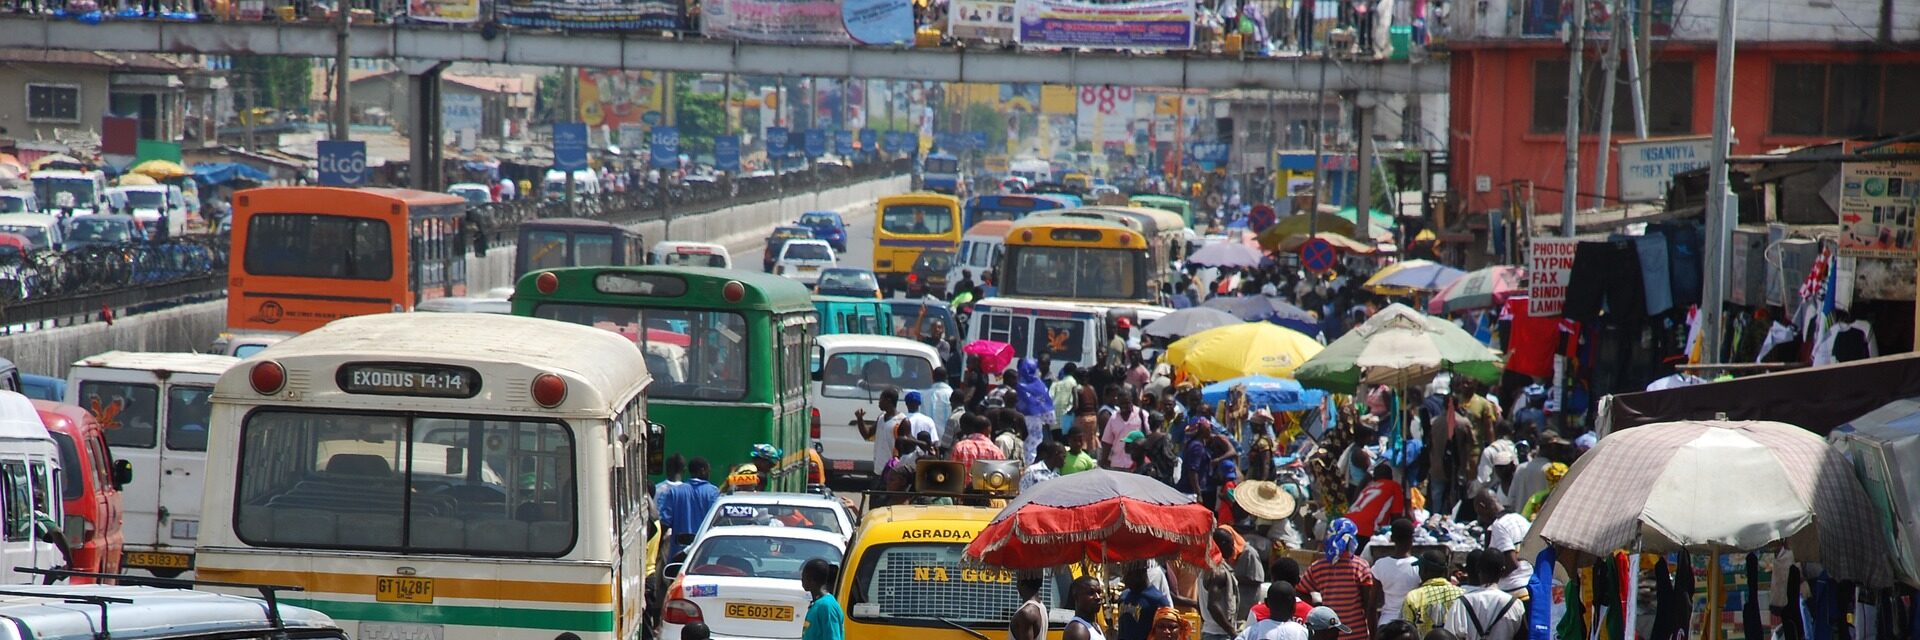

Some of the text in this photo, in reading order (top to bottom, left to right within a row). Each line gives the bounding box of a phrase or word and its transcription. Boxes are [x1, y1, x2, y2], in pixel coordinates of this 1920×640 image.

[652, 133, 679, 149] tigo
[320, 152, 366, 174] tigo
[1532, 272, 1557, 284] FAX
[354, 371, 462, 389] EXODUS 14:14
[725, 506, 752, 515] TAXI
[914, 566, 949, 582] NA
[379, 579, 393, 593] GT
[728, 605, 785, 619] GE 6031 Z
